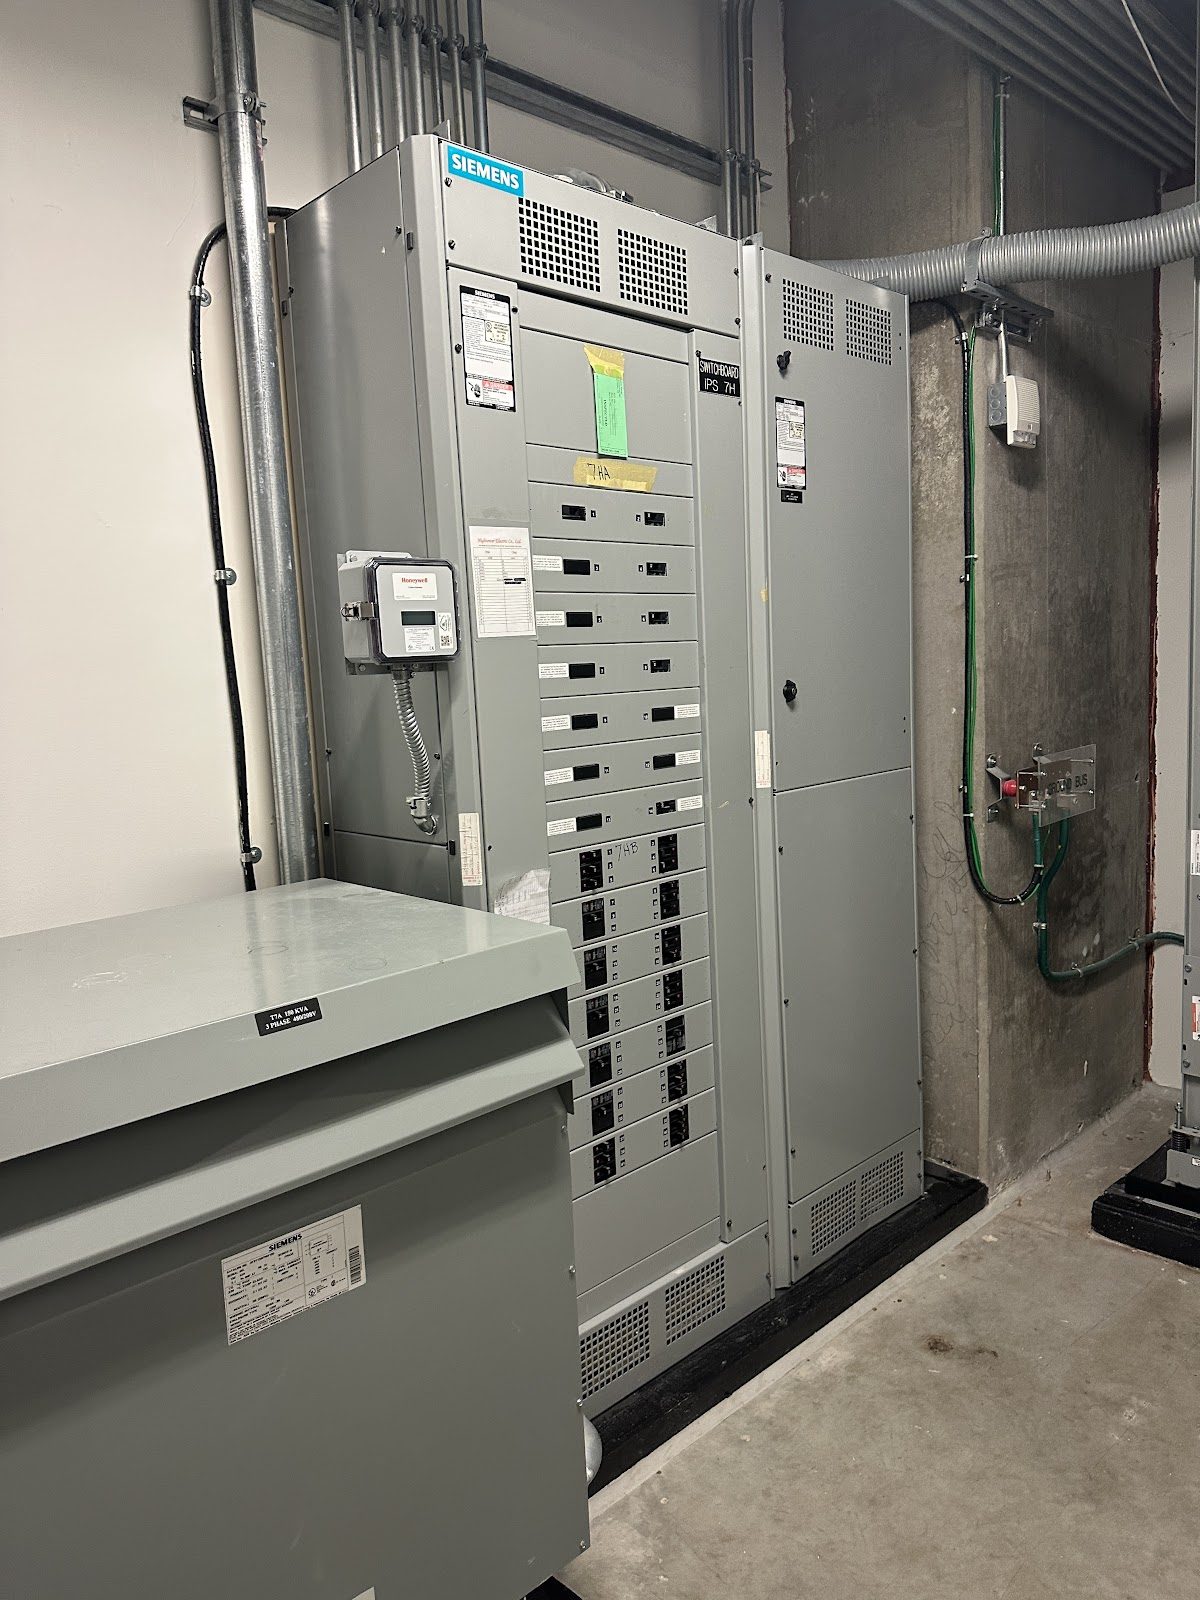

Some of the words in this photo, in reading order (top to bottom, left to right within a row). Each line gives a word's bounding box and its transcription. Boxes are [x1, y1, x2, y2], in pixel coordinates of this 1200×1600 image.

[451, 153, 520, 190] SIEMENS
[699, 360, 739, 379] SWITCHBOARD
[704, 377, 719, 392] IPS
[723, 380, 736, 395] 7H
[586, 462, 611, 481] 7HA
[401, 577, 428, 585] Honeywell
[615, 841, 639, 861] 7HB
[294, 1005, 309, 1014] KVA
[269, 1017, 292, 1029] PHASE
[268, 1233, 303, 1252] SIEMENS
